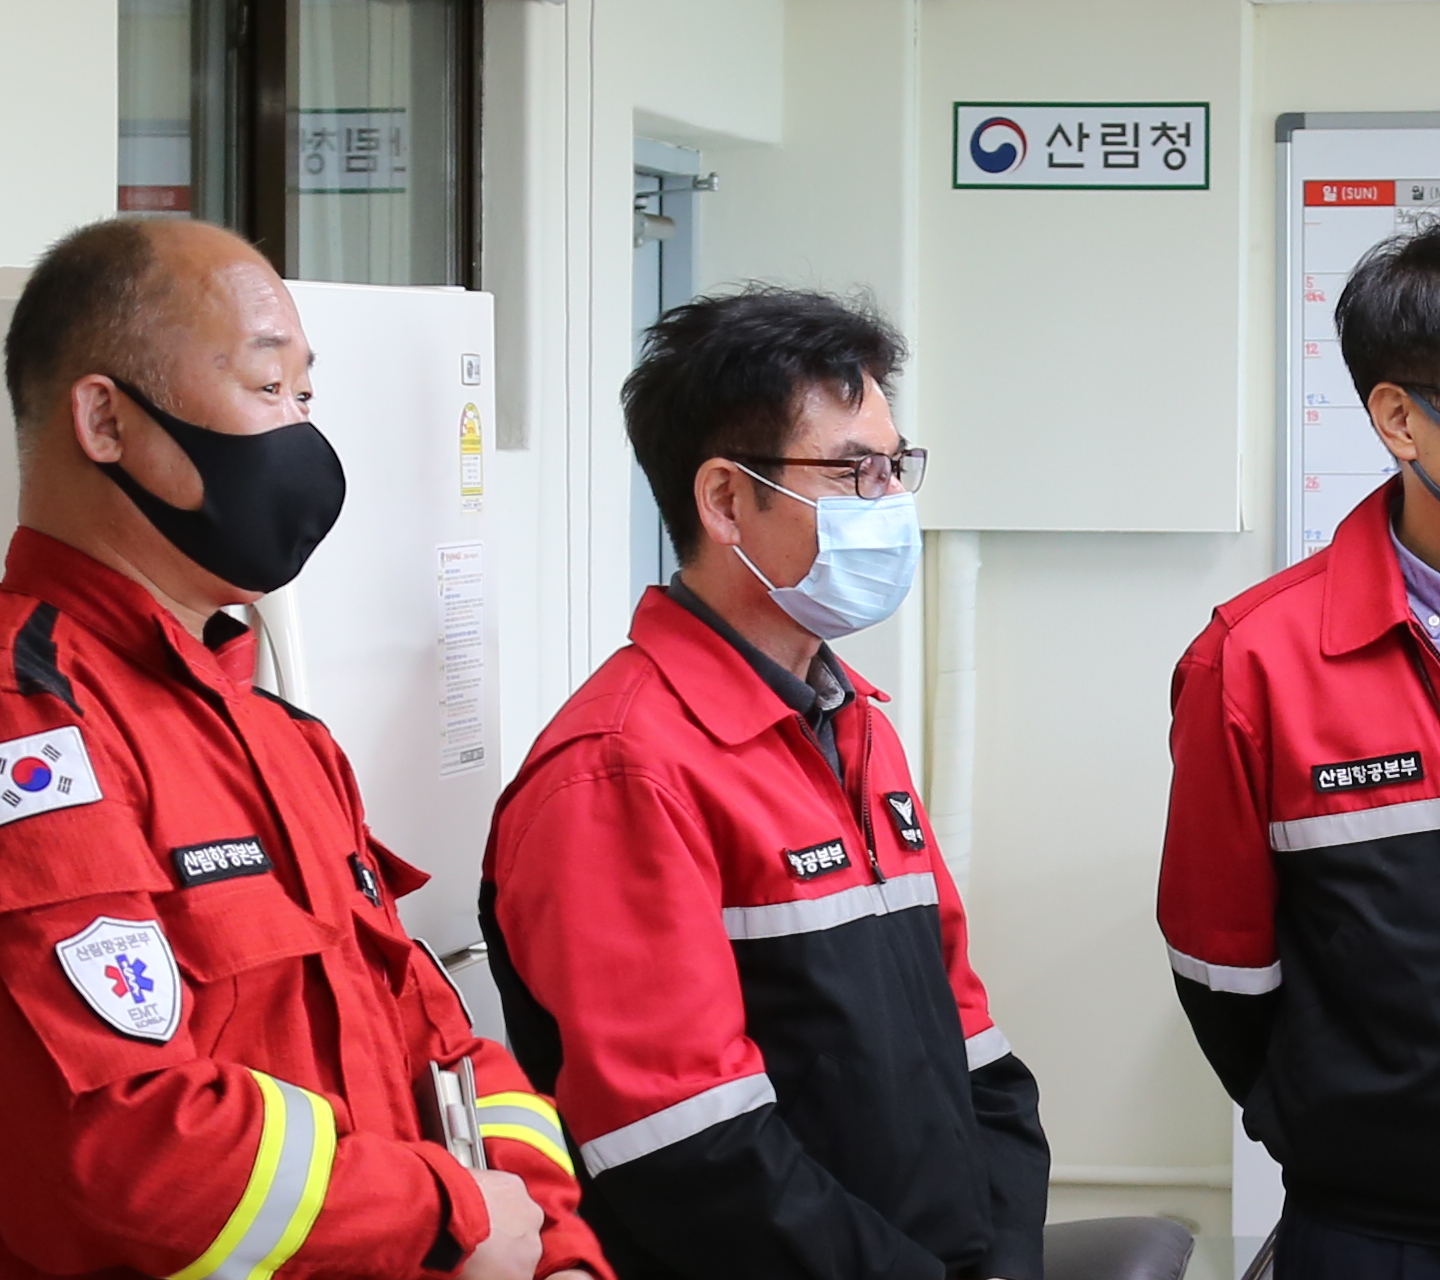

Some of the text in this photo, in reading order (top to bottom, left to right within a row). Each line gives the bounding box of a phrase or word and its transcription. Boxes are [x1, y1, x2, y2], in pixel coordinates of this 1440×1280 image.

[1046, 122, 1191, 170] 산림청
[1322, 185, 1378, 201] 일 (SUN)
[1412, 186, 1425, 200] 월
[1306, 277, 1314, 288] 5
[1305, 342, 1319, 354] 12
[1306, 410, 1319, 421] 19
[1305, 477, 1320, 489] 26
[1318, 756, 1418, 788] 산림항공본부
[182, 840, 265, 877] 산림항공본부
[75, 931, 151, 962] 산림항공본부
[128, 1003, 160, 1021] EMT
